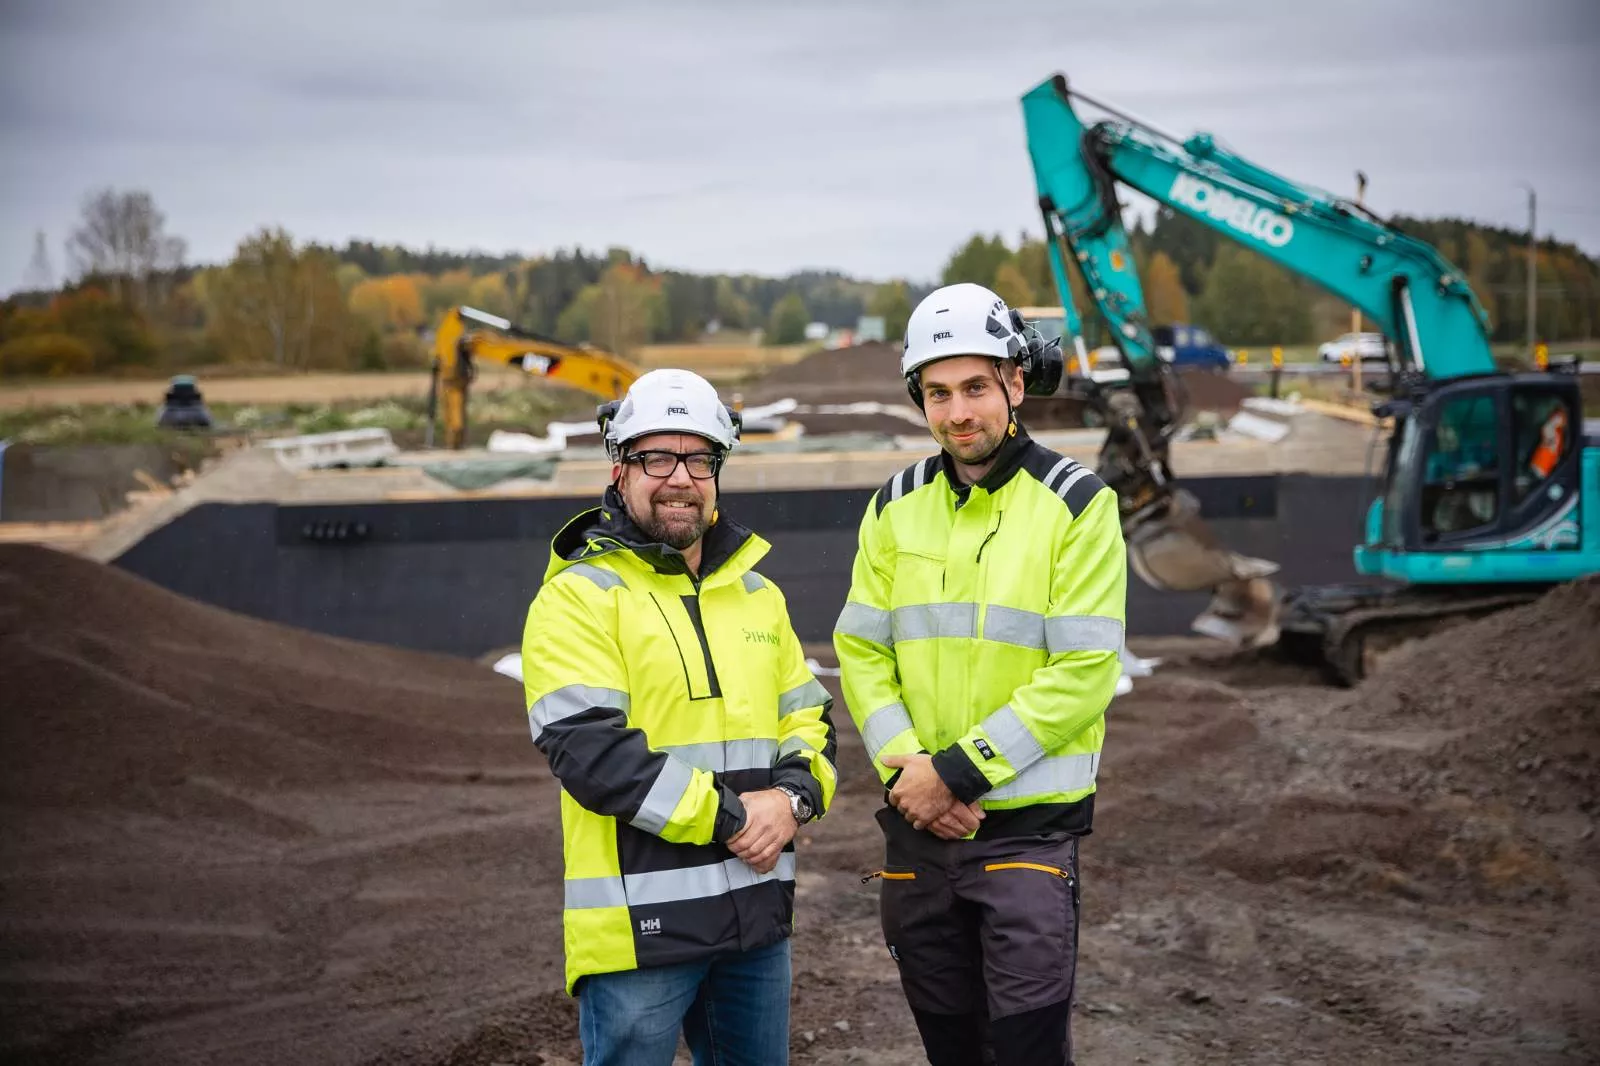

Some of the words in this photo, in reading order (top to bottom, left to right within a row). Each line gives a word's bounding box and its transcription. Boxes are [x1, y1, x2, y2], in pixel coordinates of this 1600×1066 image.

[1168, 171, 1294, 248] KOBELCO
[667, 407, 689, 416] PETZL
[640, 918, 661, 931] HH
